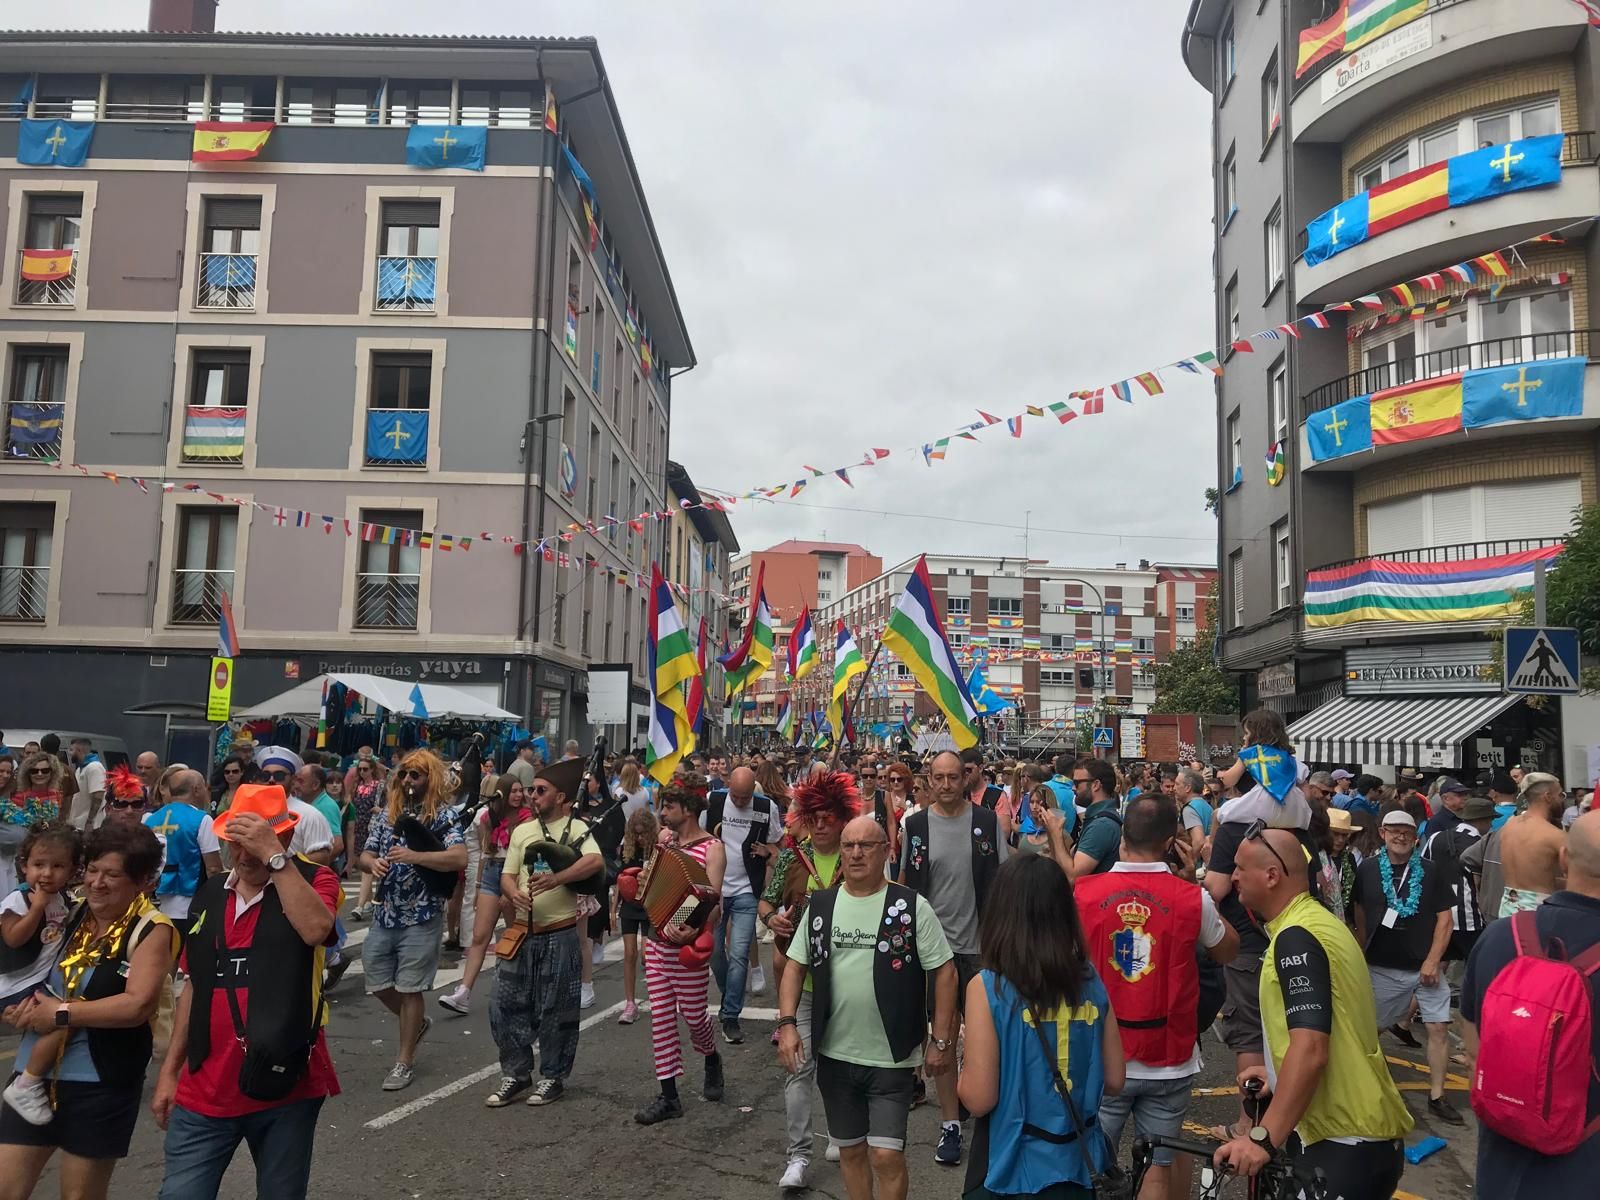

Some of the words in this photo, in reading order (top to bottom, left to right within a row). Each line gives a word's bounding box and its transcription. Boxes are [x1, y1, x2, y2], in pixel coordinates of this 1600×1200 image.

[319, 661, 412, 676] Perfumerías
[419, 660, 482, 680] yaya
[1360, 668, 1384, 681] EL
[1391, 664, 1480, 680] MIRADOR
[831, 926, 853, 942] Pepe
